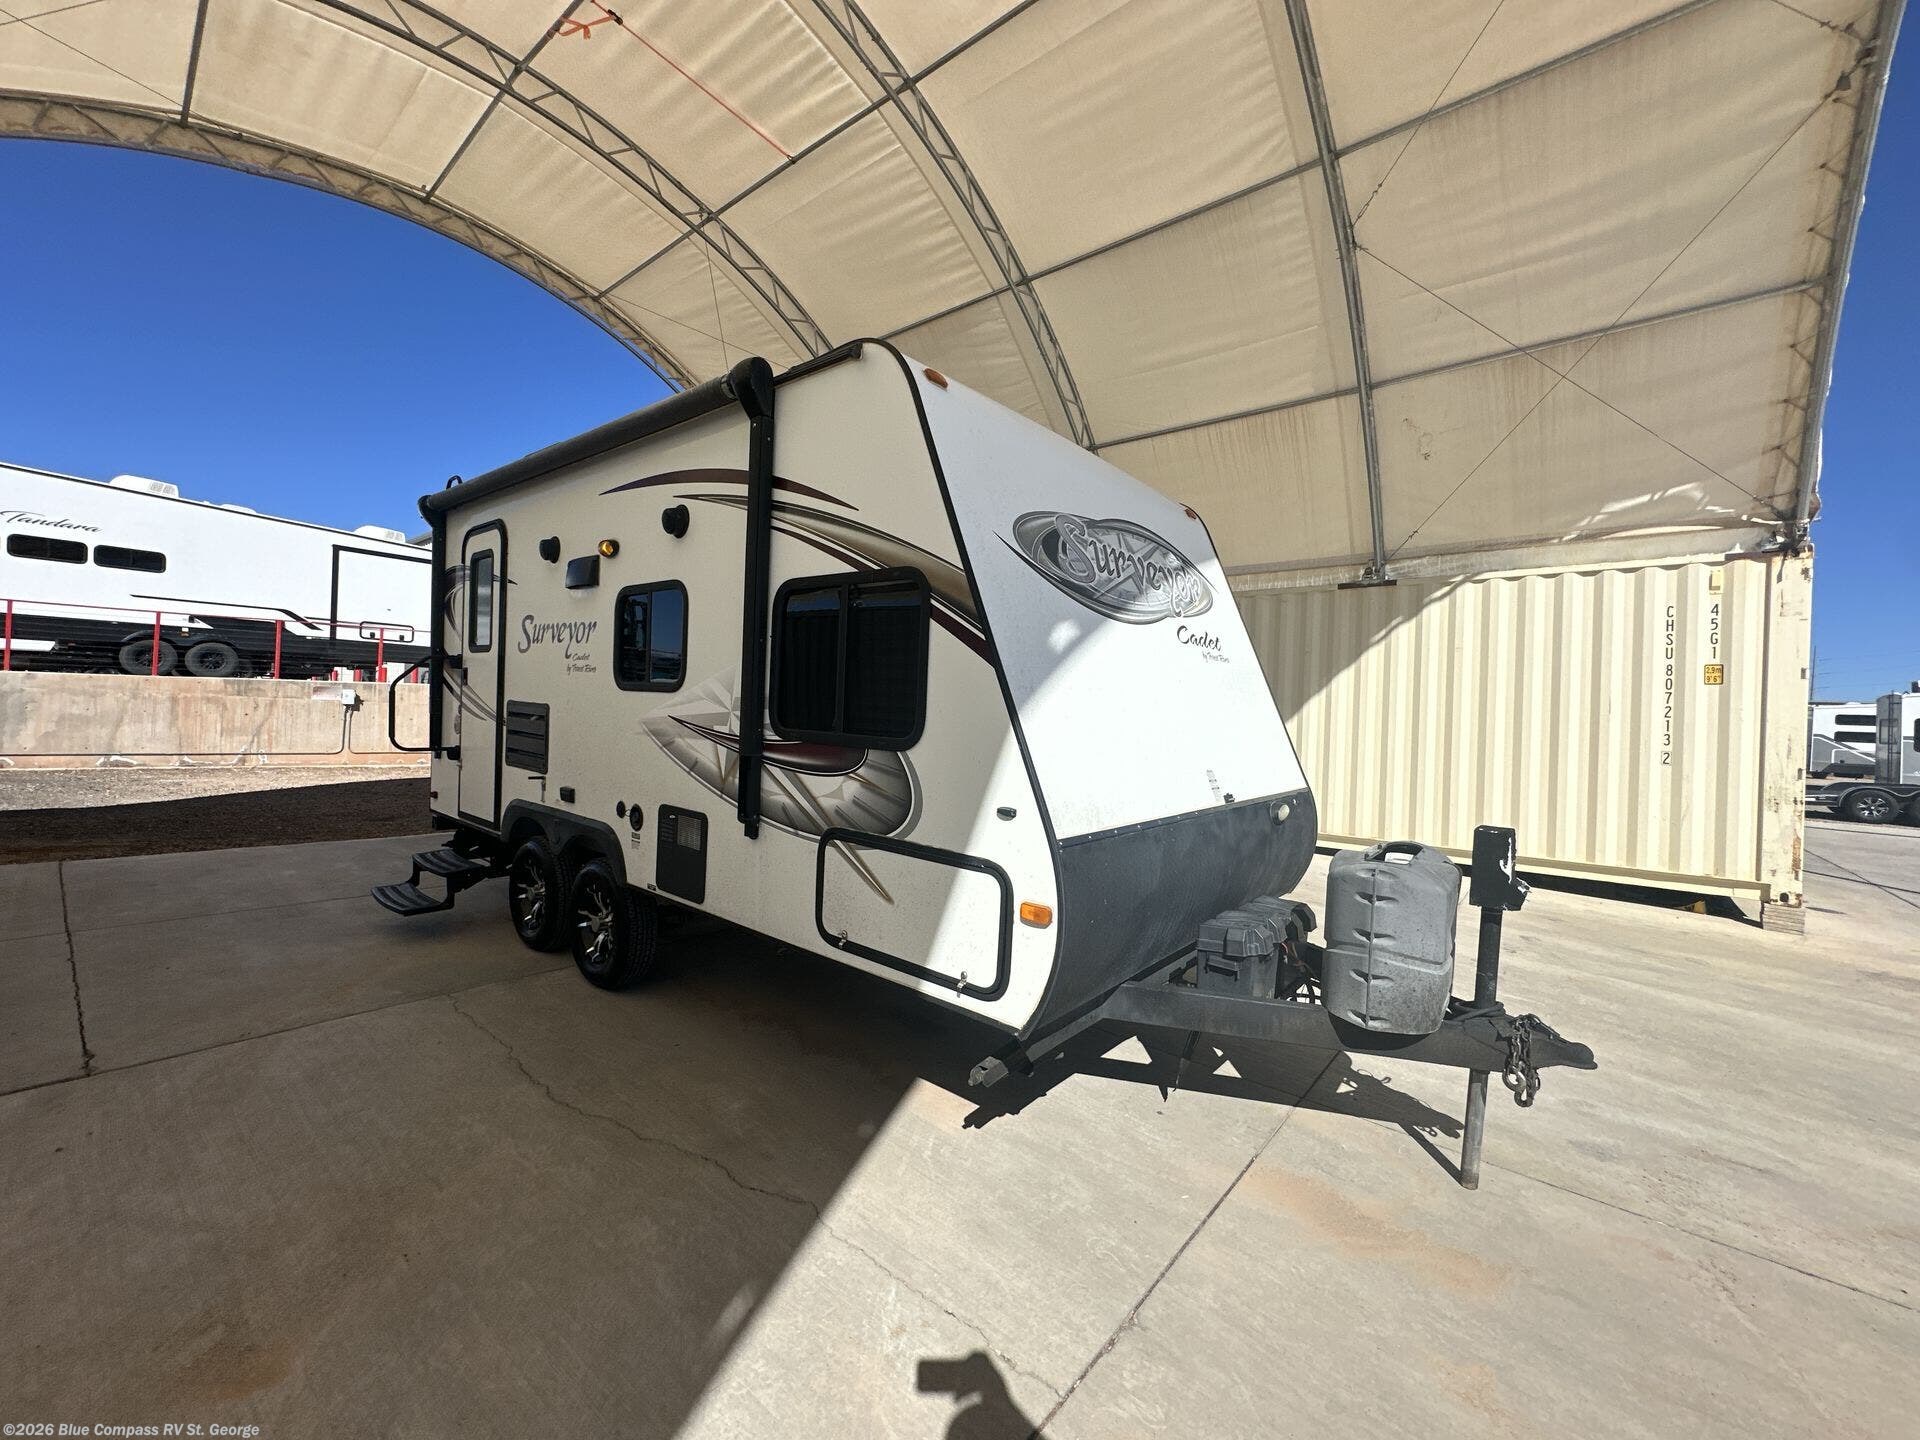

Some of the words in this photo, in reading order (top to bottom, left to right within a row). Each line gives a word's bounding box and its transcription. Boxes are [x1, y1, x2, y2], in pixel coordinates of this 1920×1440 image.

[0, 510, 102, 532] Tandara
[1055, 514, 1201, 618] Surveyor
[518, 614, 597, 659] Surveyor
[1177, 625, 1221, 651] Cadet
[1710, 603, 1719, 659] 45G1
